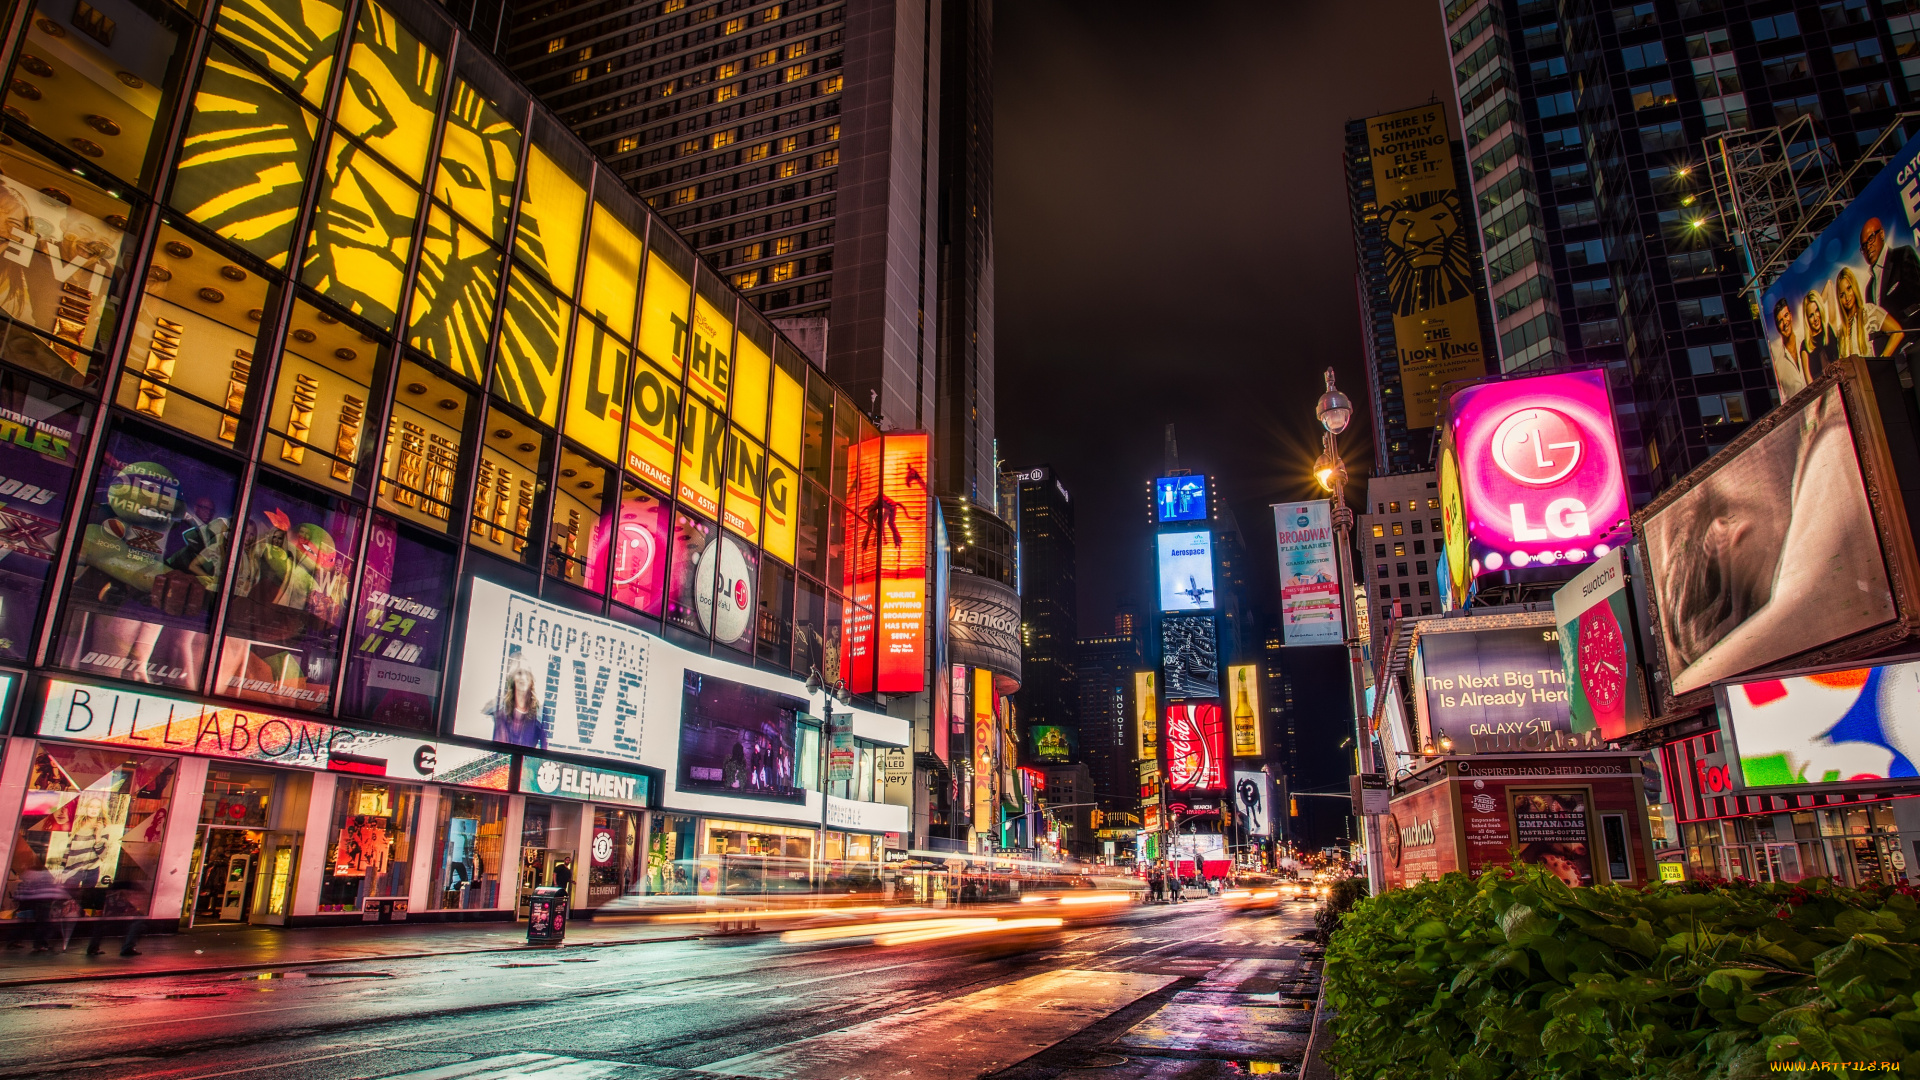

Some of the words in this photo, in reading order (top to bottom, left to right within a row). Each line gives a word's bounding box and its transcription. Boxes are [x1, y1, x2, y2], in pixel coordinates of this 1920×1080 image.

[1423, 112, 1436, 123] IS
[1382, 124, 1432, 143] SIMPLY
[1373, 135, 1445, 157] NOTHING
[1394, 150, 1428, 165] ELSE
[1385, 164, 1418, 179] LIKE
[1424, 327, 1451, 340] THE
[670, 311, 729, 392] THE
[1400, 348, 1437, 366] LION
[1440, 342, 1479, 360] KING
[1444, 357, 1481, 367] LANDMARK
[1418, 369, 1446, 377] MUCAL
[585, 308, 697, 454] LION
[699, 395, 787, 516] KING
[630, 455, 671, 486] ENTRANCE
[681, 486, 694, 501] ON
[698, 496, 716, 513] 45TH
[724, 511, 745, 530] STREET
[1509, 498, 1591, 542] LG
[1278, 527, 1330, 545] BROADWAY
[1171, 548, 1205, 557] Aerospace
[1301, 541, 1332, 551] MARKET
[1306, 557, 1330, 565] AUCTION
[1582, 569, 1611, 598] swatch
[367, 590, 441, 621] SATURDAY
[883, 601, 922, 609] ANYTHING
[365, 608, 417, 637] 4.29
[883, 612, 923, 620] BROADWAY
[884, 622, 900, 630] HAS
[901, 622, 920, 630] EVER
[969, 624, 996, 637] driving
[1592, 621, 1599, 630] 12
[1602, 622, 1606, 631] 1
[1586, 630, 1592, 640] 11
[1608, 631, 1614, 643] 2
[382, 639, 424, 664] AM
[1584, 664, 1589, 672] 9
[1424, 676, 1454, 691] The
[1458, 673, 1499, 689] Next
[1504, 671, 1534, 689] Big
[1589, 678, 1594, 687] 8
[1610, 682, 1616, 691] 5
[1439, 693, 1455, 708] Is
[1460, 689, 1526, 708] Already
[1531, 689, 1568, 704] Here
[1595, 689, 1600, 698] 7
[1604, 691, 1609, 700] 6
[1116, 694, 1124, 746] NOVOTEL
[64, 689, 355, 766] BILLABONG
[1469, 721, 1523, 736] GALAXY
[1168, 715, 1191, 782] Coca-Cola
[1469, 767, 1516, 777] INSPIRED
[1519, 766, 1583, 776] HAND-HELD
[1585, 765, 1622, 775] FOODS
[560, 768, 636, 800] ELEMENT
[1518, 820, 1585, 828] EMPANADAS
[1400, 815, 1435, 848] nuchas
[1669, 871, 1682, 879] CAB
[589, 885, 617, 896] ELEMENT
